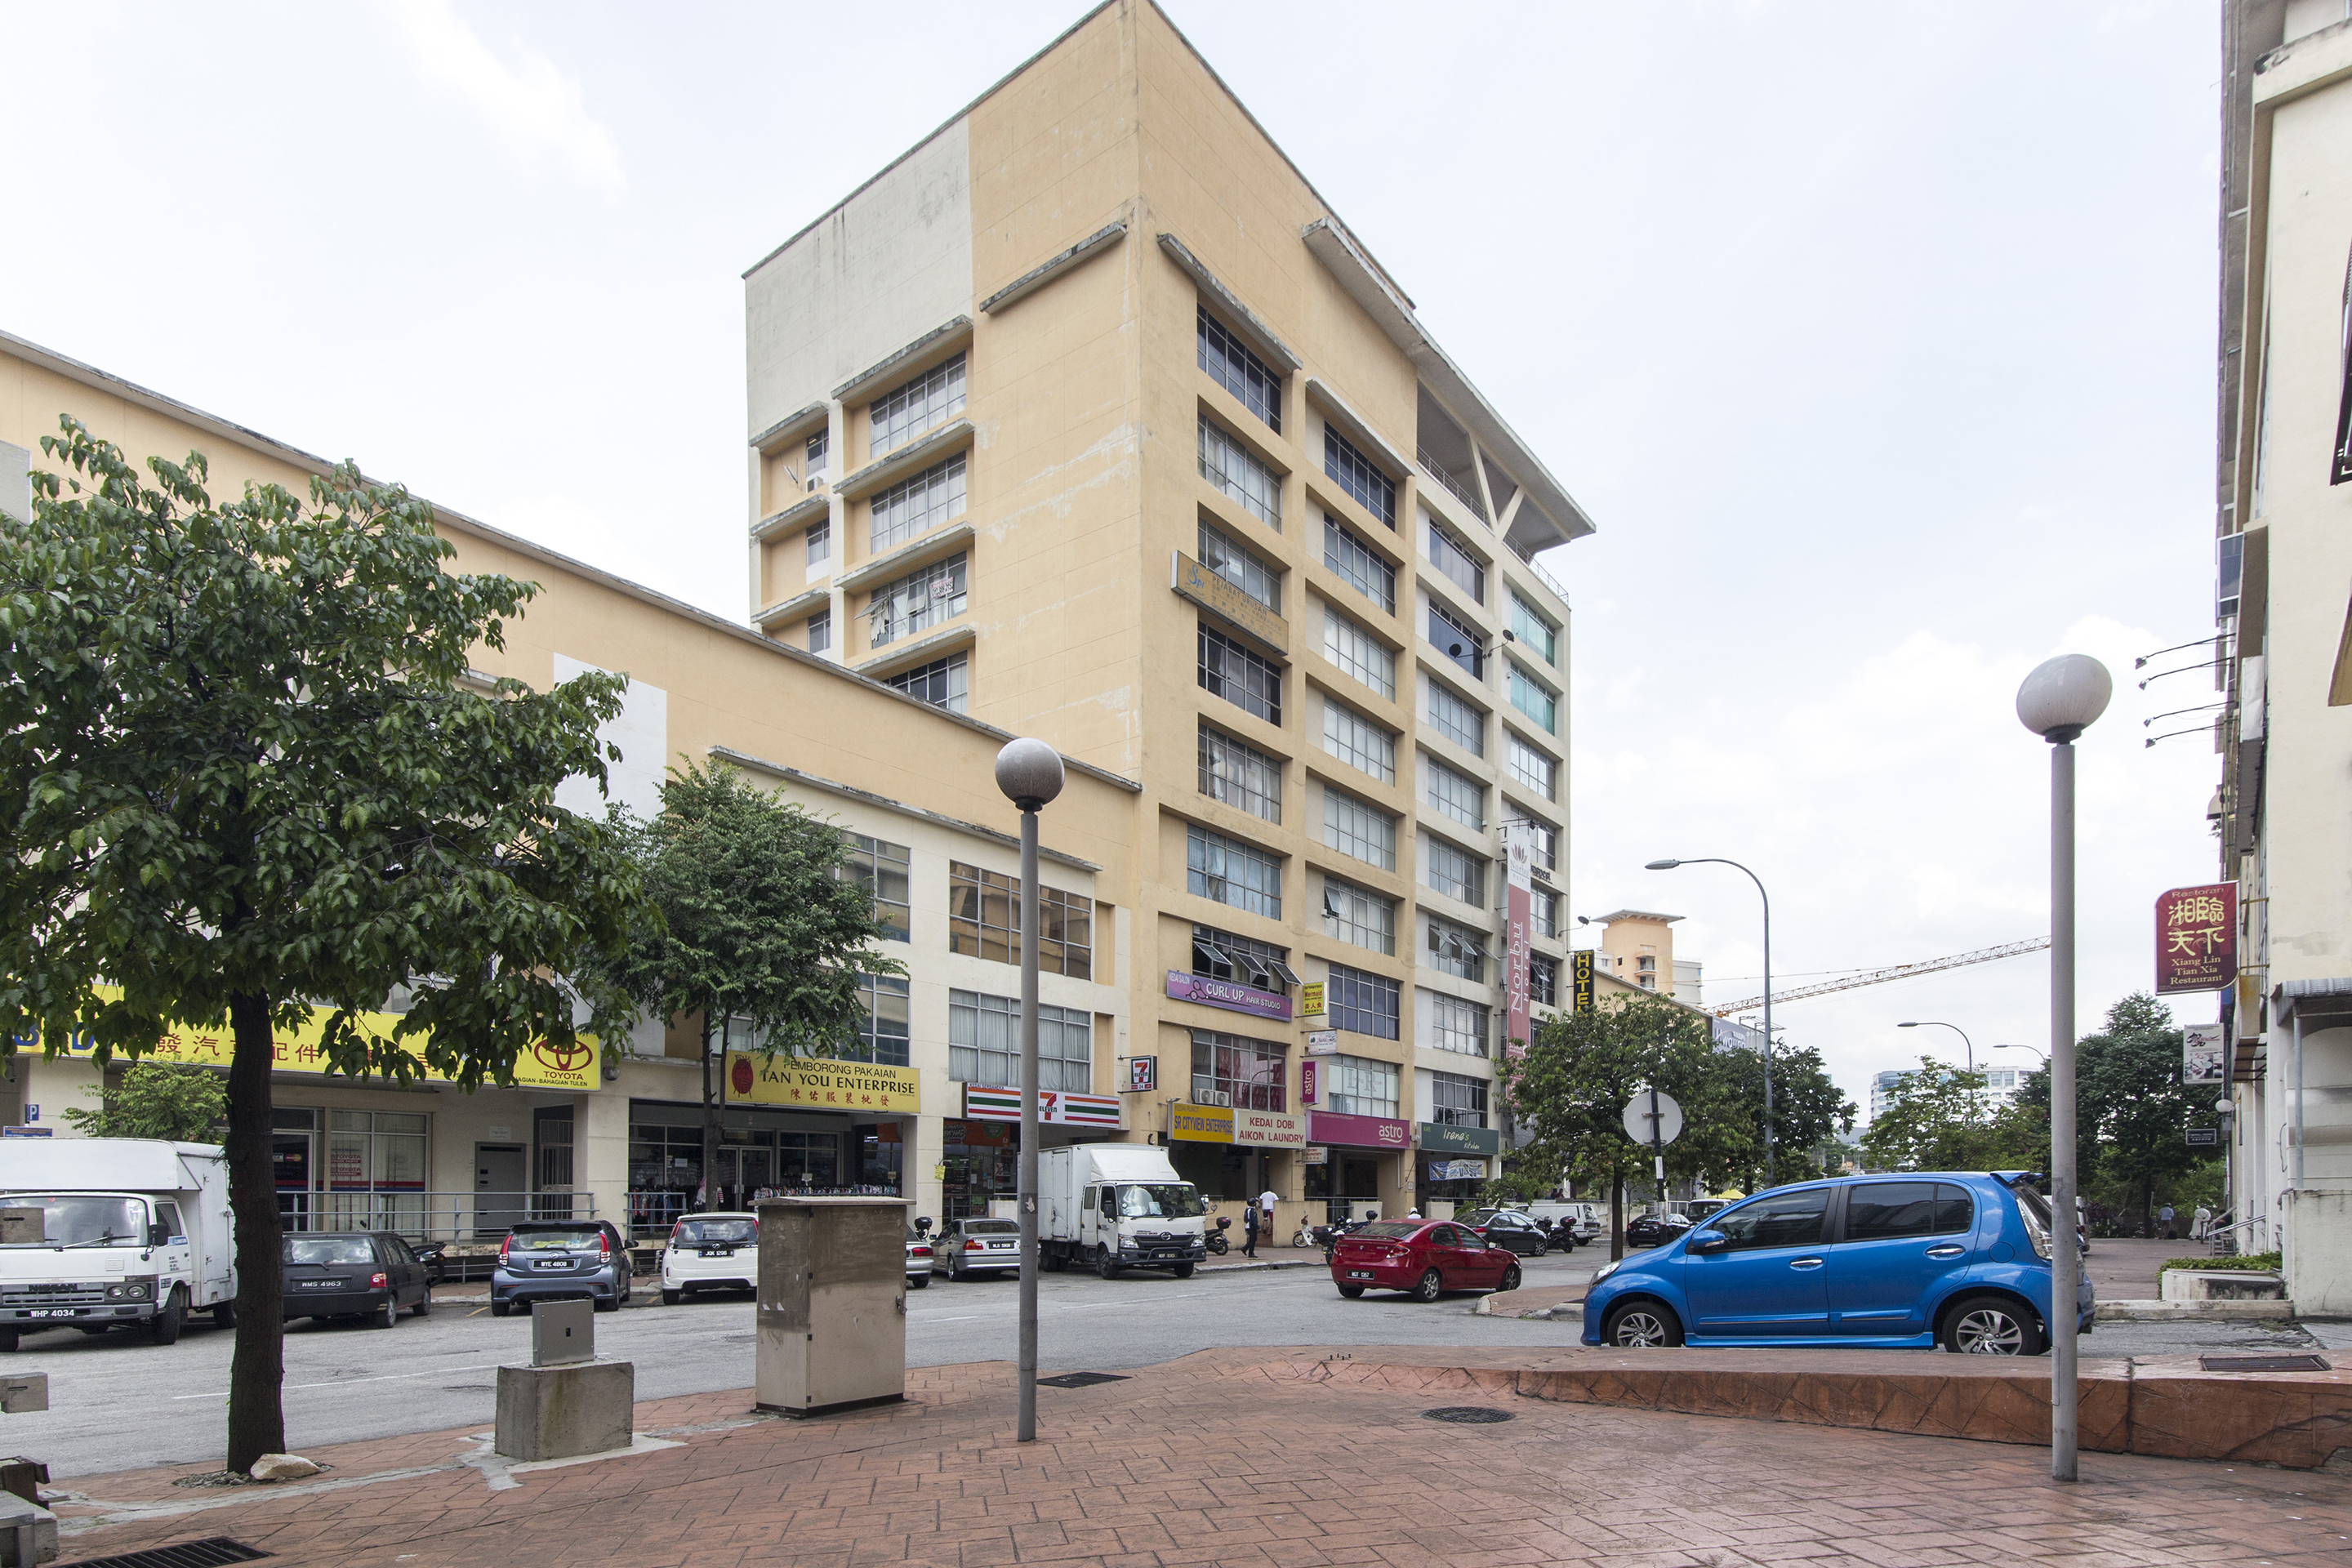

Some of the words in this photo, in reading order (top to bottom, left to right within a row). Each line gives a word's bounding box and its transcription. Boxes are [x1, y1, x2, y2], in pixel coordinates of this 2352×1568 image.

[1212, 576, 1241, 599] PEJABAT
[1242, 595, 1267, 616] URUSAN
[1510, 859, 1530, 876] Norbu
[2172, 887, 2224, 898] Restoran
[2167, 926, 2225, 956] 天下
[2172, 958, 2201, 966] Xiang
[2203, 956, 2221, 964] Lin
[1510, 923, 1521, 1013] Norbu
[2175, 968, 2198, 976] Tian
[2200, 965, 2217, 974] Xia
[1169, 972, 1178, 982] KEDAI
[1179, 974, 1190, 985] SALON
[2170, 975, 2222, 985] Restaurant
[1206, 982, 1230, 999] CURL
[1232, 988, 1245, 1000] UP
[1246, 996, 1259, 1005] HAIR
[1260, 999, 1281, 1010] STUDIO
[544, 1071, 583, 1080] TOYOTA
[854, 1067, 896, 1079] PAKAIAN
[800, 1073, 830, 1088] YOU
[837, 1076, 915, 1094] ENTERPRISE
[30, 1105, 38, 1120] P
[1183, 1116, 1205, 1131] CITYVIEW
[1205, 1118, 1232, 1134] ENTERPRISE
[1250, 1116, 1272, 1127] KEDAI
[1276, 1120, 1294, 1129] DOBI
[1239, 1130, 1264, 1140] AIKON
[1268, 1133, 1303, 1143] LAUNDRY
[1379, 1124, 1403, 1138] astro
[1443, 1129, 1469, 1141] Irene's
[1463, 1141, 1480, 1150] Kitchen
